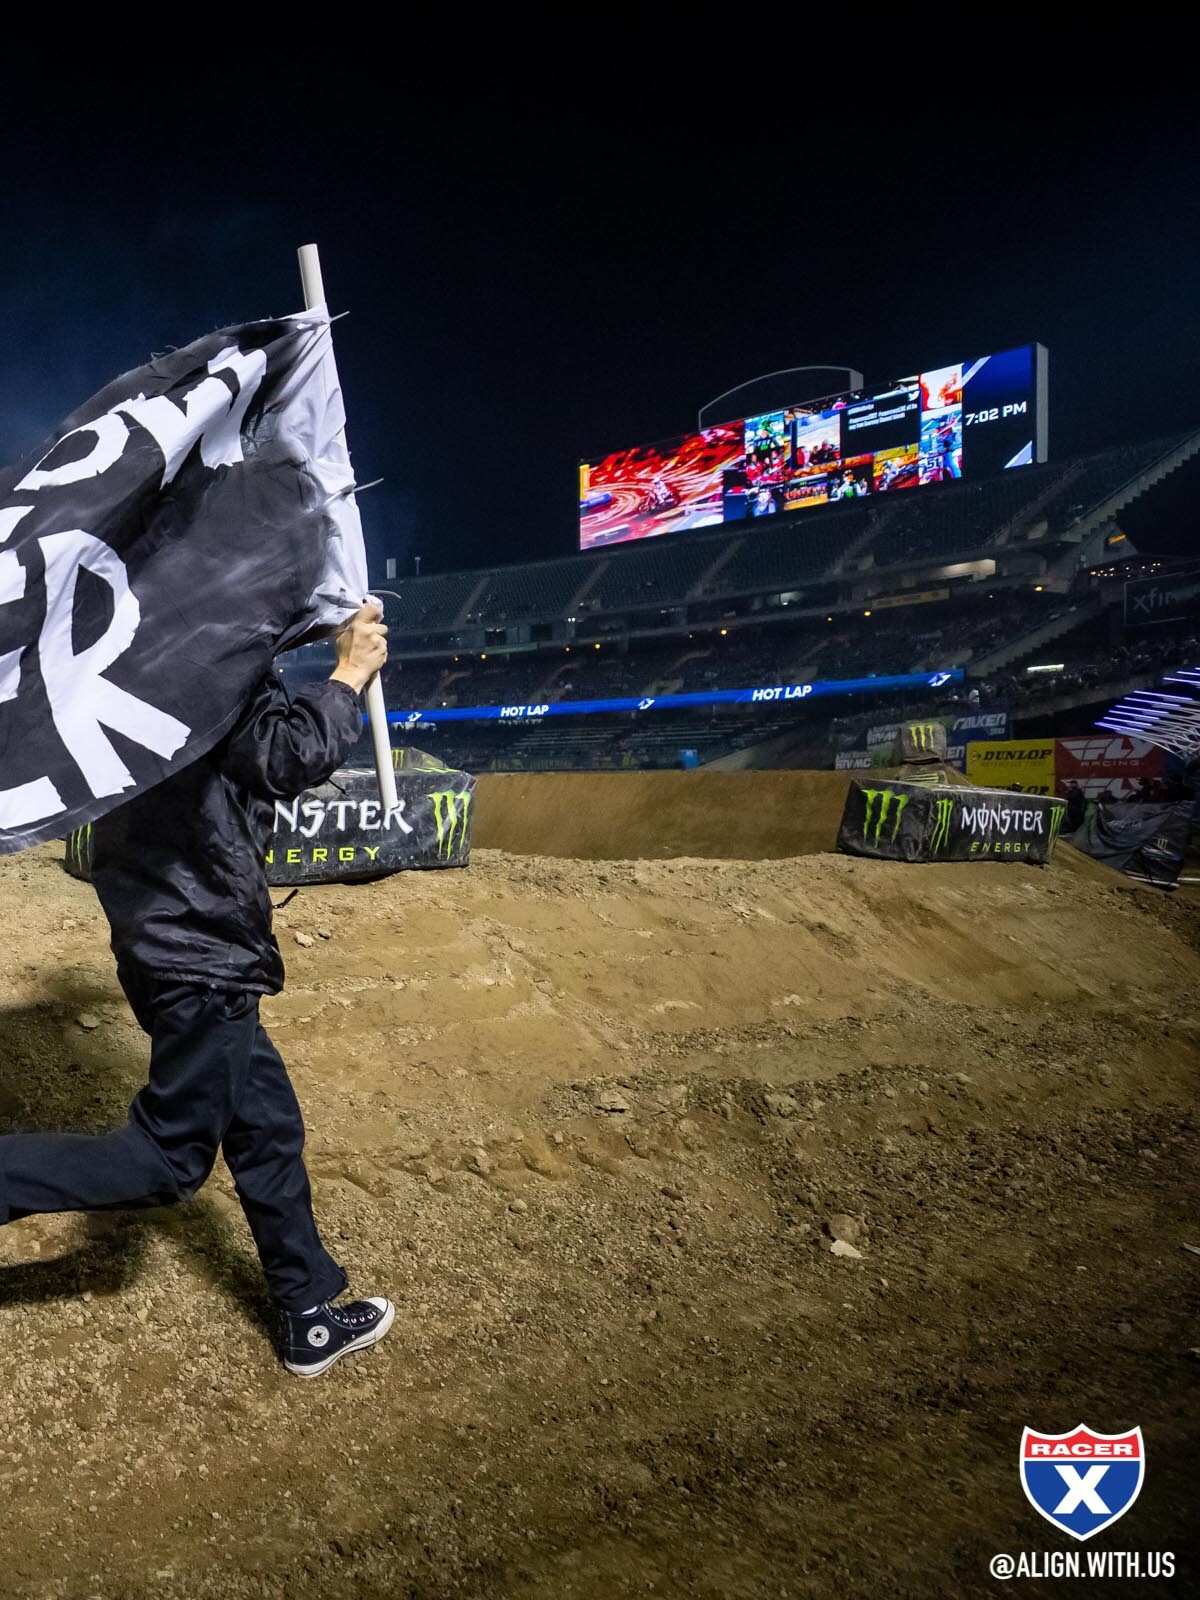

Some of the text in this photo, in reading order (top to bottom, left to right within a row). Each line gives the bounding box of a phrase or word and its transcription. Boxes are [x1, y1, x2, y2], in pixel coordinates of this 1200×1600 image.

[965, 401, 1027, 426] 7:02 PM
[752, 685, 812, 701] HOT LAP
[500, 704, 549, 717] HOT LAP
[953, 713, 1007, 731] FALKEN
[983, 749, 1052, 760] DUNLOP
[1080, 759, 1141, 767] RACING
[970, 842, 1031, 853] ENERGY
